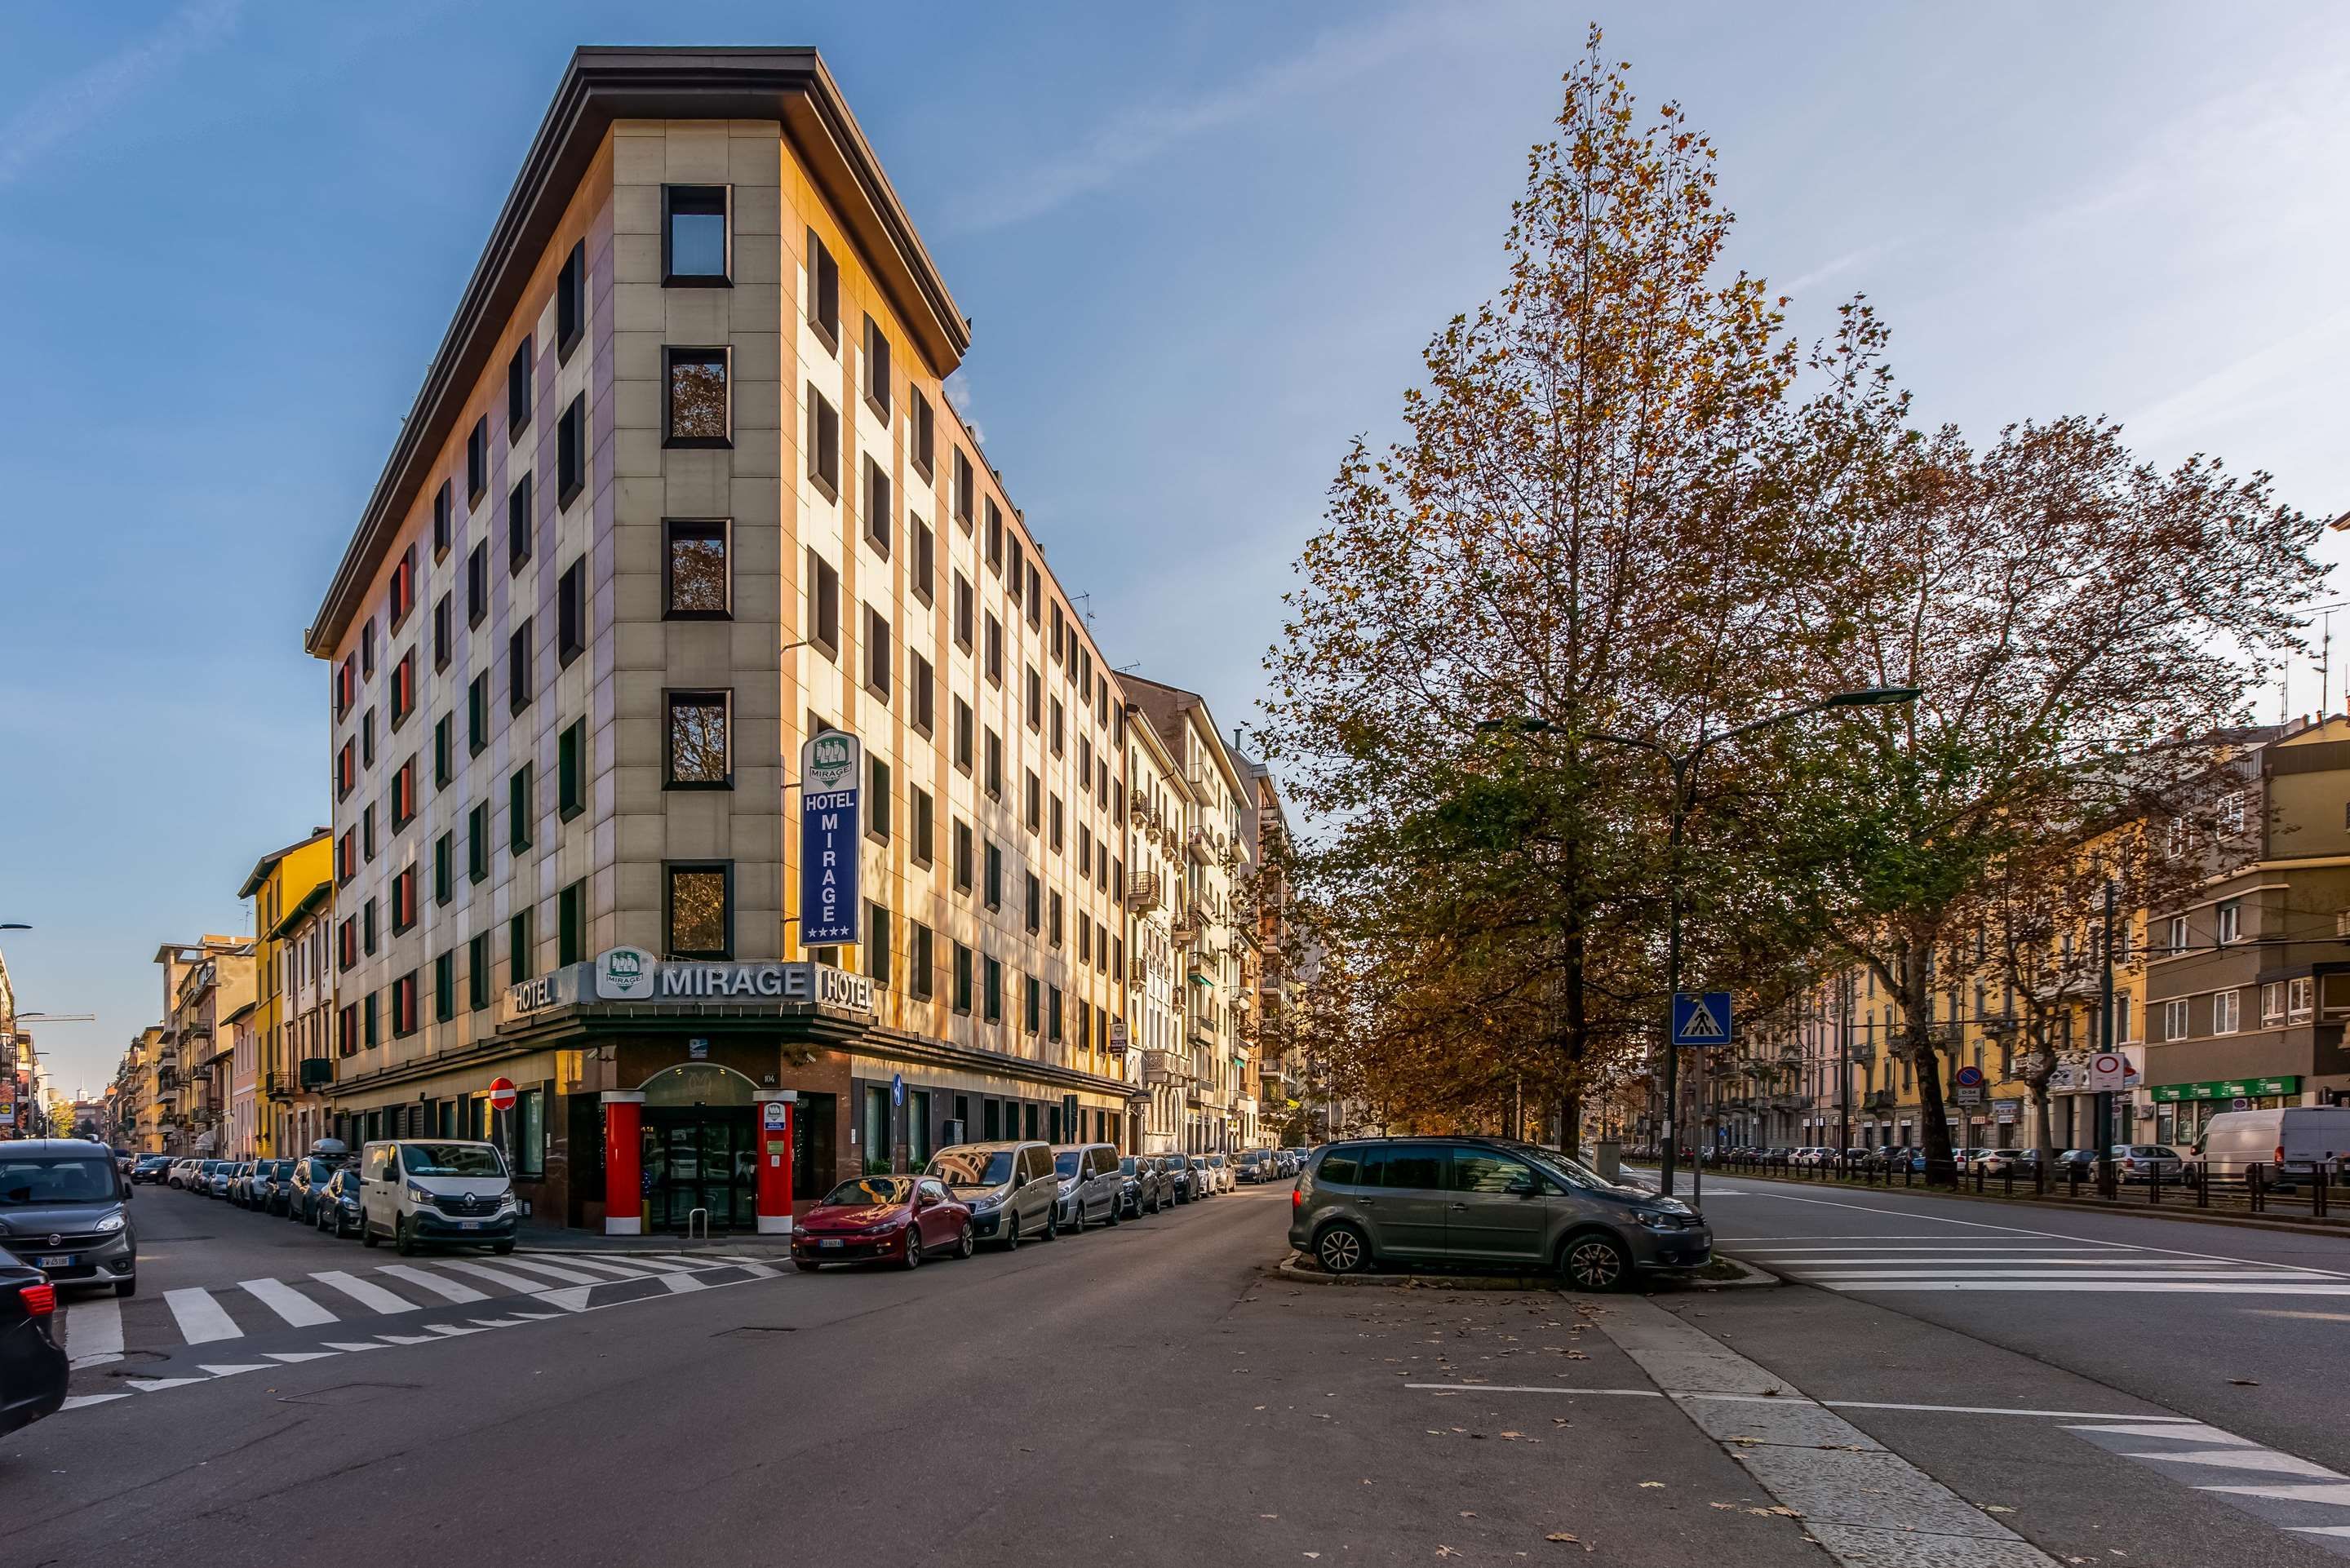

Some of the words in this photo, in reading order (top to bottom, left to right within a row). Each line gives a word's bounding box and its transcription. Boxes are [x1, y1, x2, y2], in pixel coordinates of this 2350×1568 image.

[811, 767, 849, 778] MIRAGE
[806, 792, 854, 811] HOTEL
[822, 813, 837, 922] MIRAGE
[608, 976, 641, 984] MIRAGE
[662, 968, 807, 996] MIRAGE
[827, 969, 873, 1008] HOTEL
[515, 977, 552, 1012] HOTEL
[764, 1074, 775, 1083] 104
